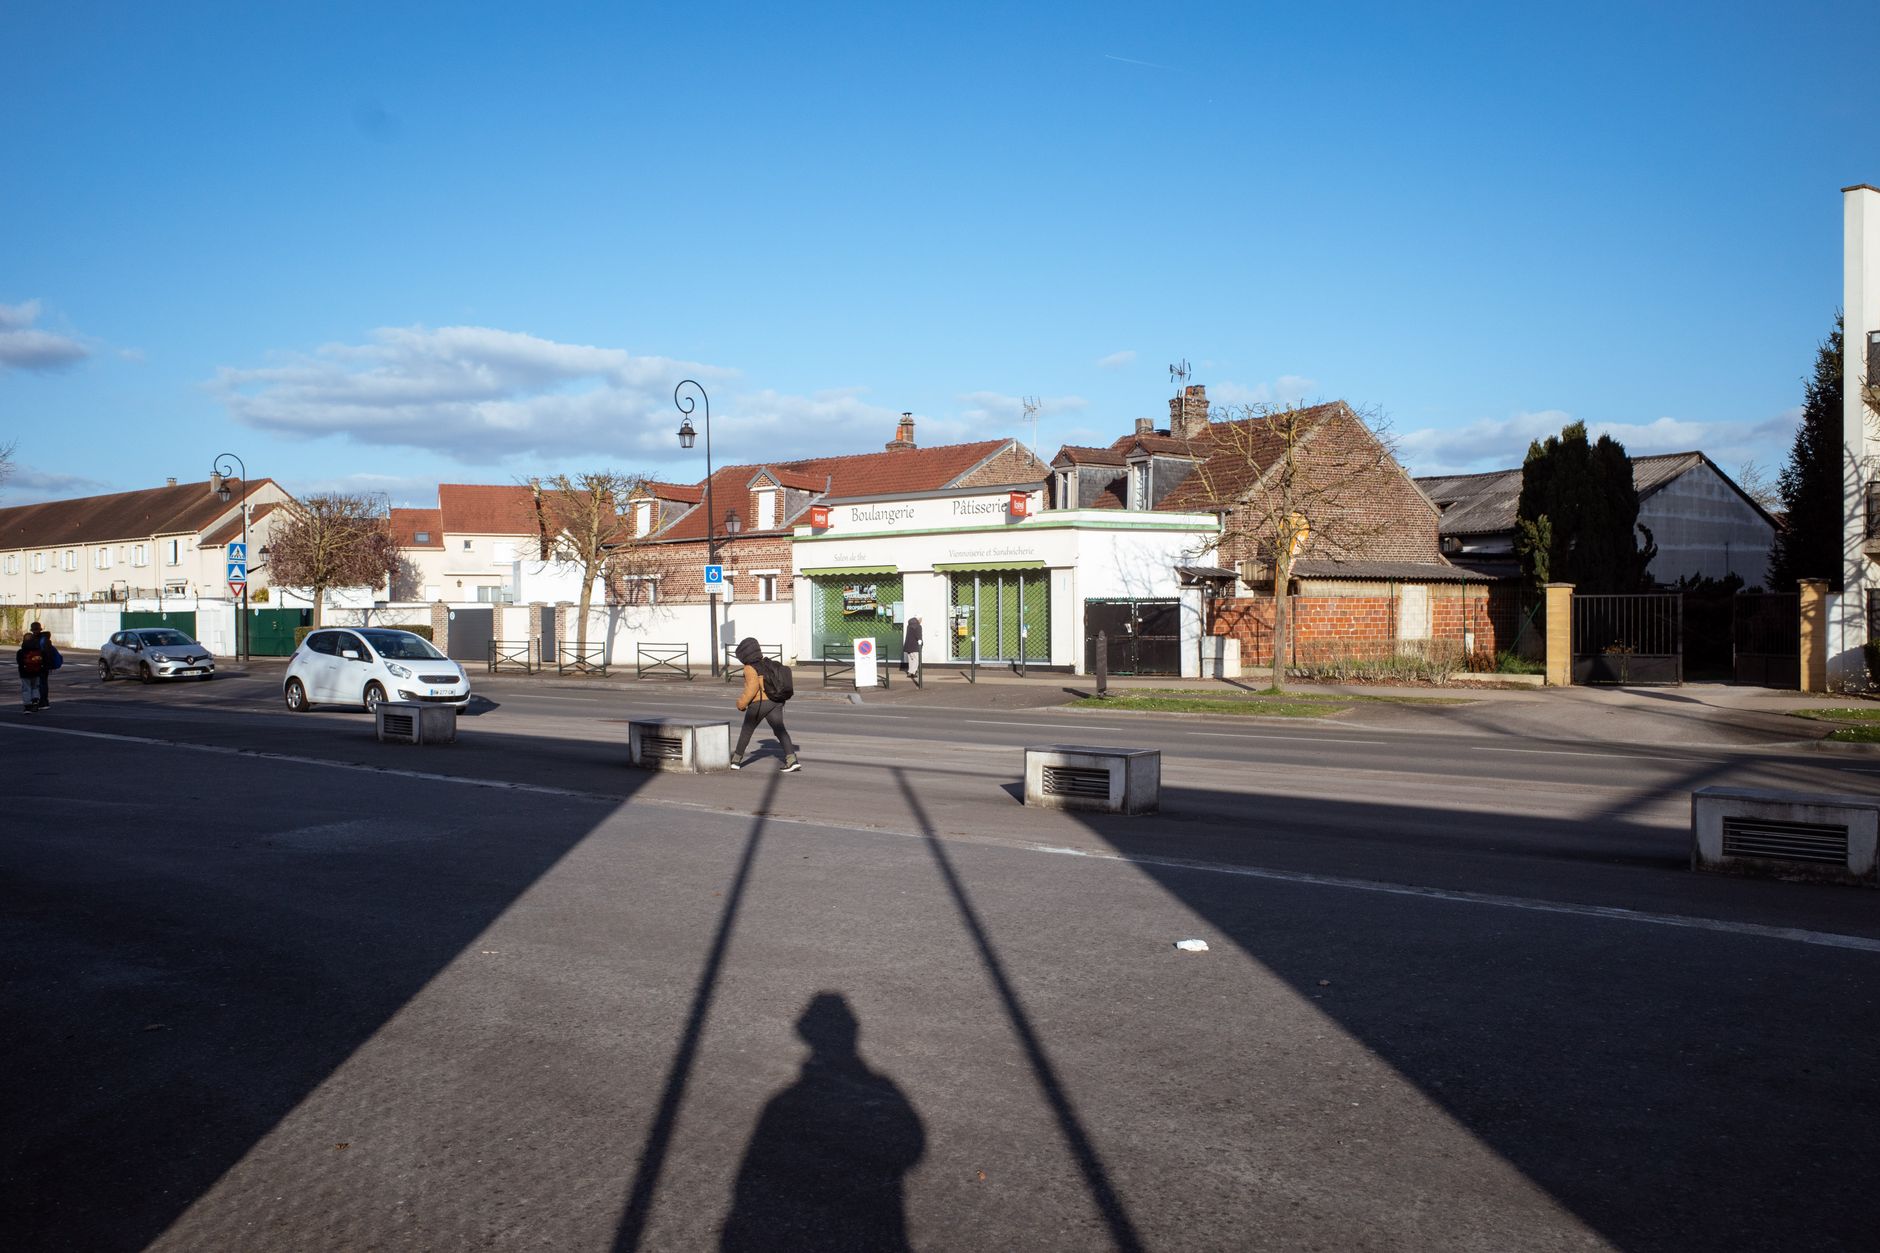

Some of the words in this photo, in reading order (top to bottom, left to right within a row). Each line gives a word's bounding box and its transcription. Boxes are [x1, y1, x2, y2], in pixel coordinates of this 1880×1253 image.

[851, 504, 915, 525] Boulangerie
[953, 498, 1008, 515] Pâtisserie
[993, 545, 1035, 557] Sandwicherie
